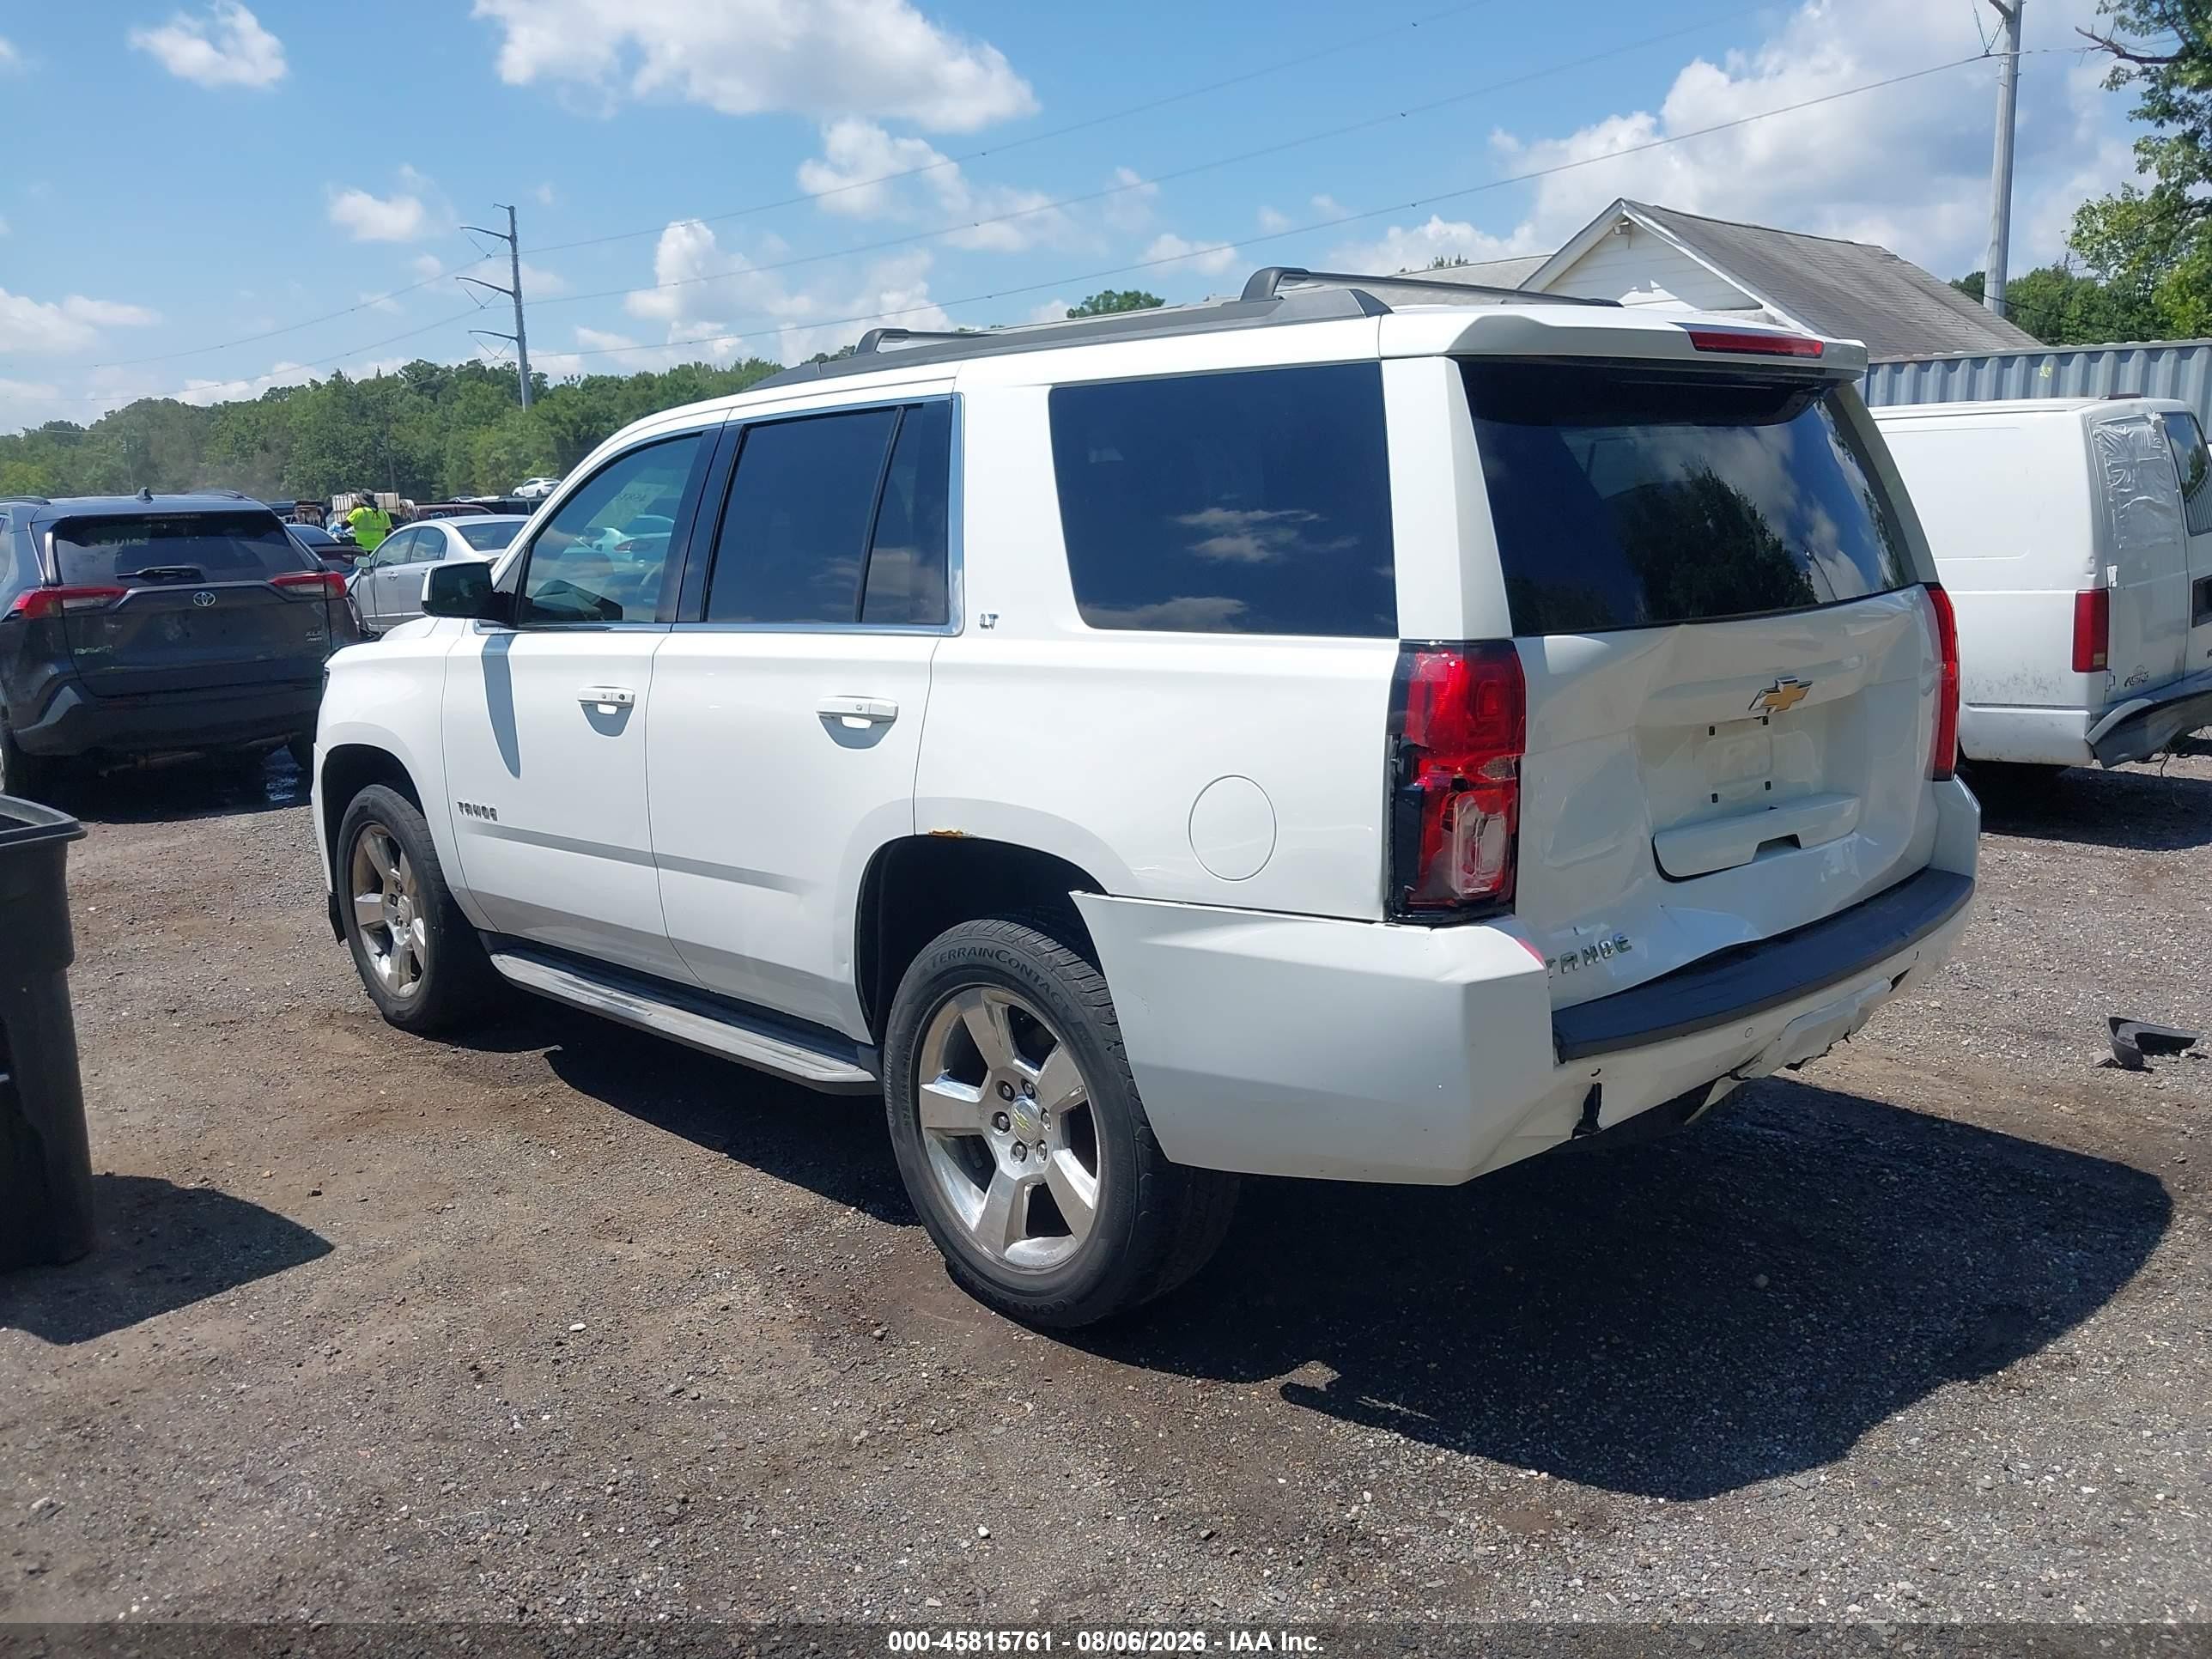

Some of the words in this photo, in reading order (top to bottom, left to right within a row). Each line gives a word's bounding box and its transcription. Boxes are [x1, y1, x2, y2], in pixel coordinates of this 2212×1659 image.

[979, 613, 999, 629] LT
[457, 801, 498, 821] TAHOE
[1545, 933, 1632, 978] TAHOE
